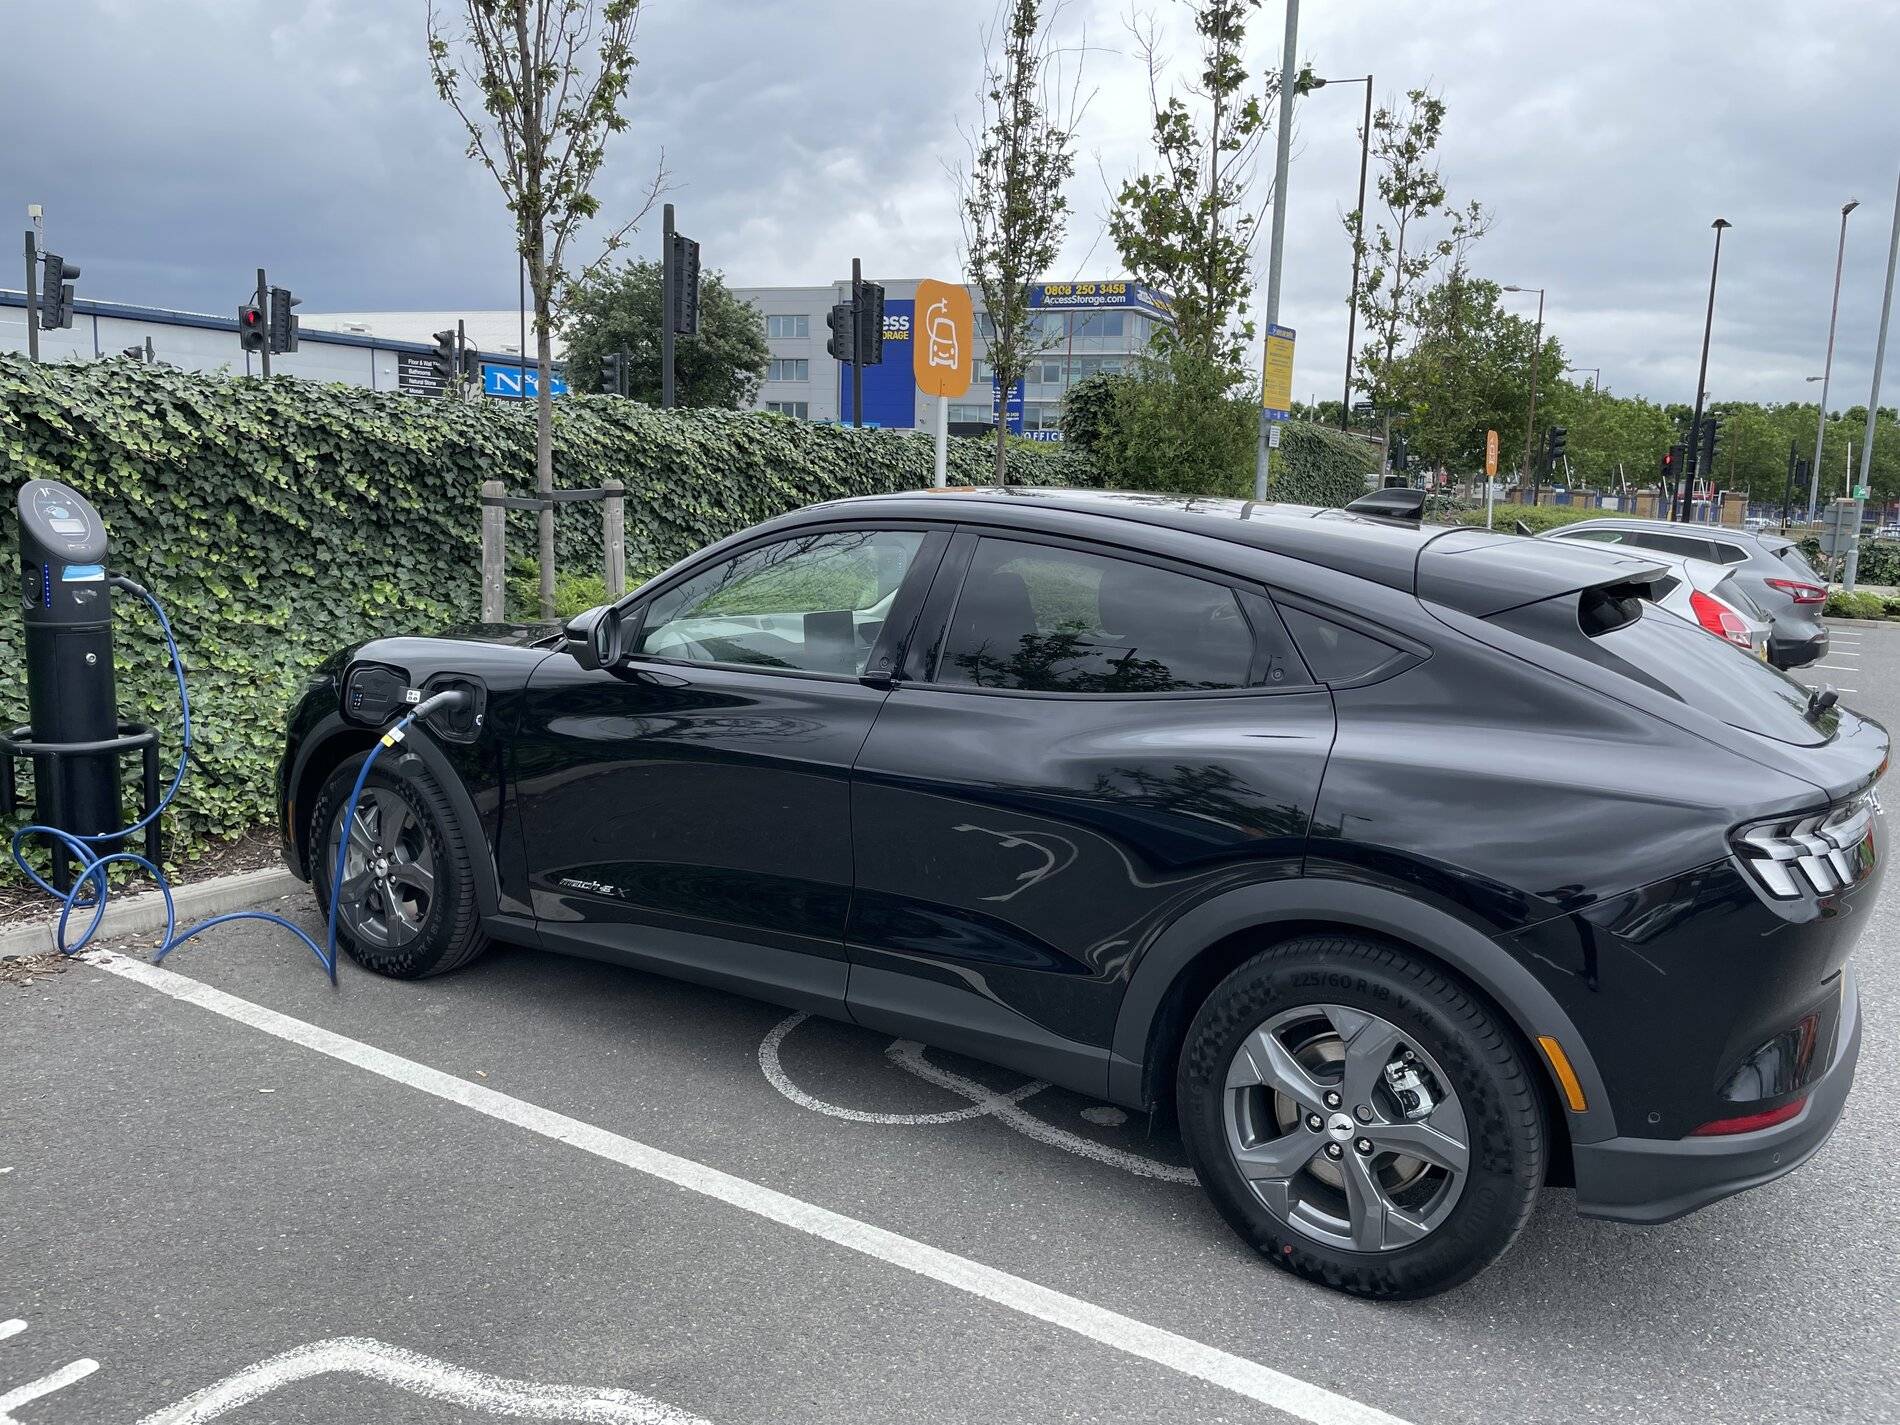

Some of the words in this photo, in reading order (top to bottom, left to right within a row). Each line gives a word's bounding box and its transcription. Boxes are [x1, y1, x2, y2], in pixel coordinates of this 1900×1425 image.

[1075, 284, 1095, 295] 250
[1099, 283, 1126, 295] 3458
[1044, 294, 1126, 305] AccessStorage.com
[883, 315, 910, 330] ess
[883, 331, 909, 340] ORAGE
[408, 368, 431, 376] Bathrooms
[409, 387, 425, 395] Mosaic
